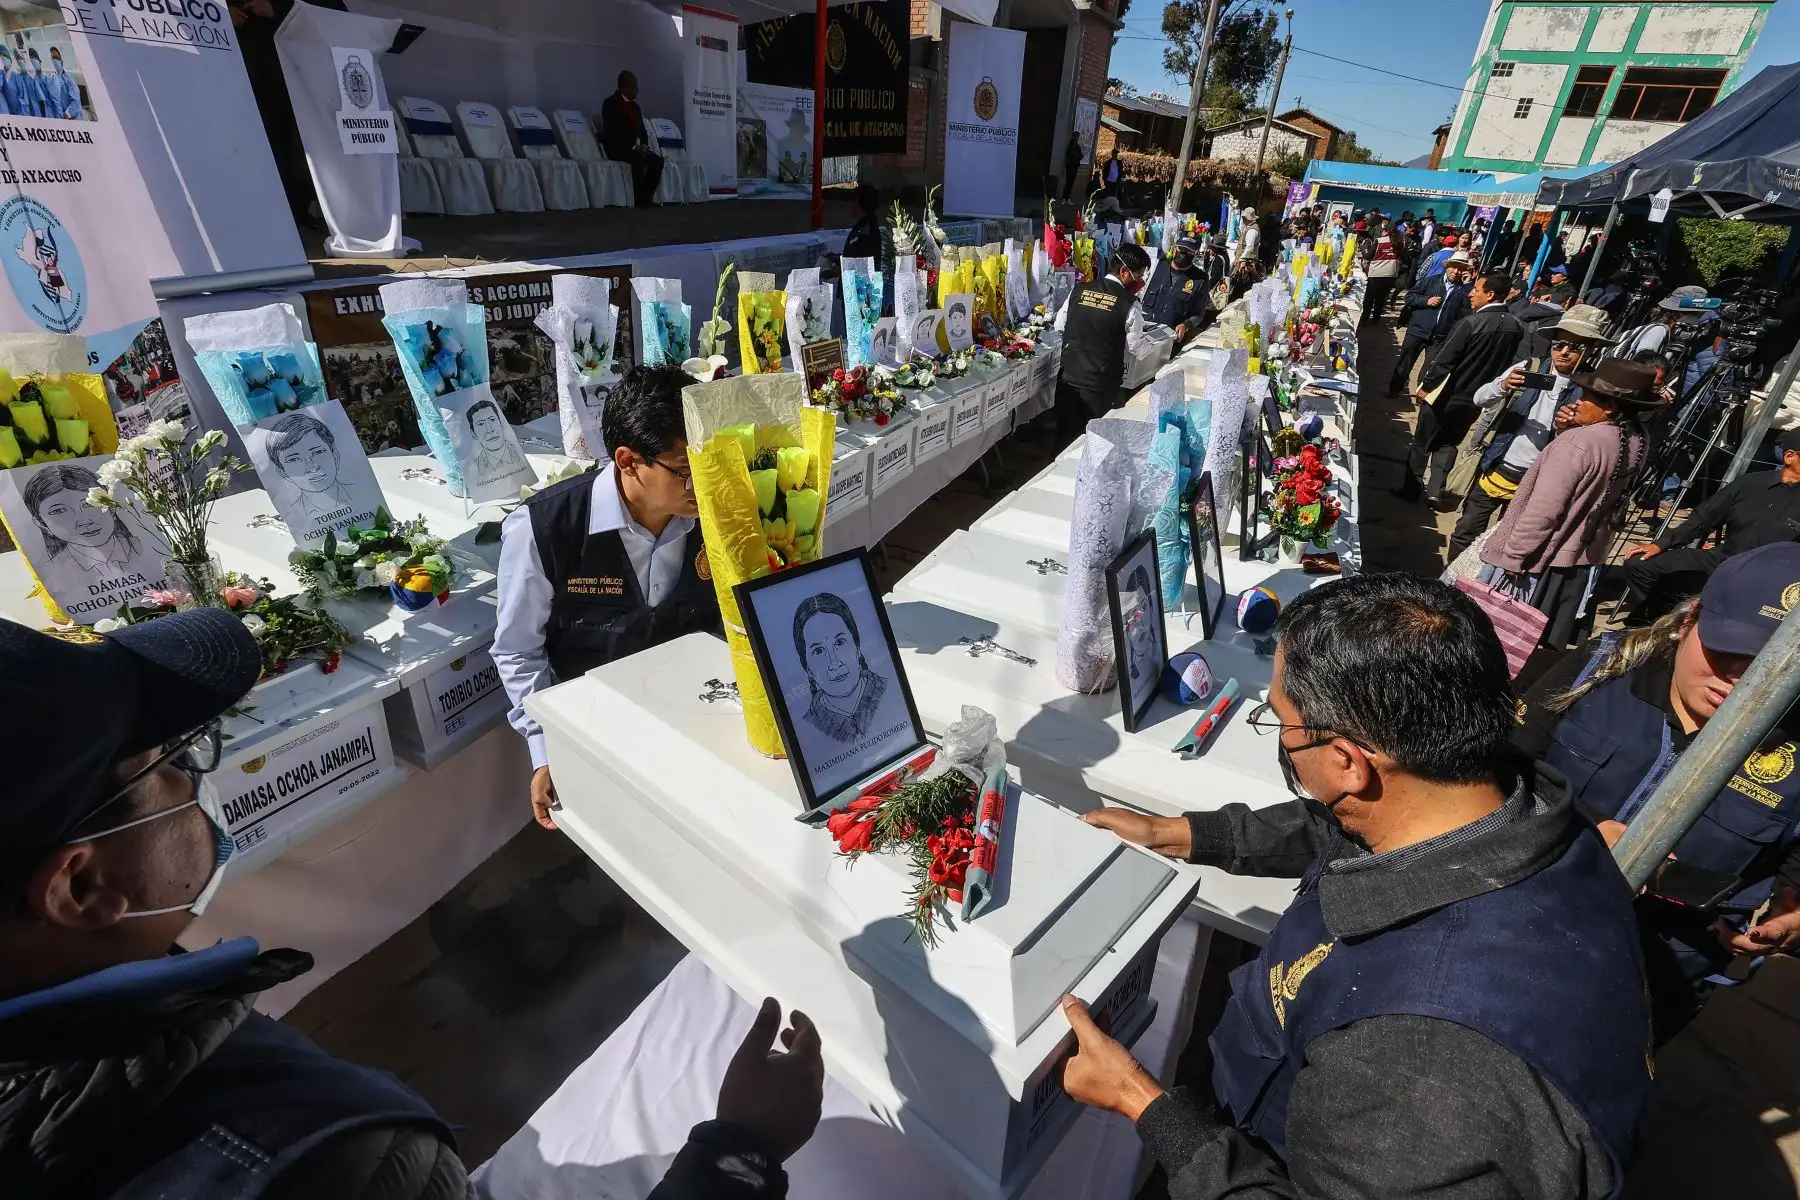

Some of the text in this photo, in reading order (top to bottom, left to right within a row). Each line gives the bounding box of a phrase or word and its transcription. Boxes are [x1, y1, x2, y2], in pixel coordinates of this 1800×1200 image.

[61, 6, 230, 46] DE LA NACIÓN
[341, 118, 389, 129] MINISTERIO
[949, 124, 987, 134] MINISTERIO
[25, 127, 94, 145] MOLECULAR
[1, 169, 82, 184] DE AYACUCHO
[487, 282, 552, 302] ACCOMA
[314, 506, 353, 525] TORIBIO
[304, 511, 376, 541] OCHOA JANAMPA
[88, 572, 147, 596] DÁMASA
[567, 574, 624, 586] MINISTERIO PÚBLICO
[66, 595, 118, 615] OCHOA
[438, 679, 473, 713] TORIBIO
[445, 714, 466, 734] EFE
[814, 720, 908, 774] MAXIMILIANA PULIDO ROMERO
[222, 735, 370, 825] DAMASA OCHOA JANAMPA
[338, 769, 380, 795] 20-05-2022
[235, 824, 266, 850] EFE
